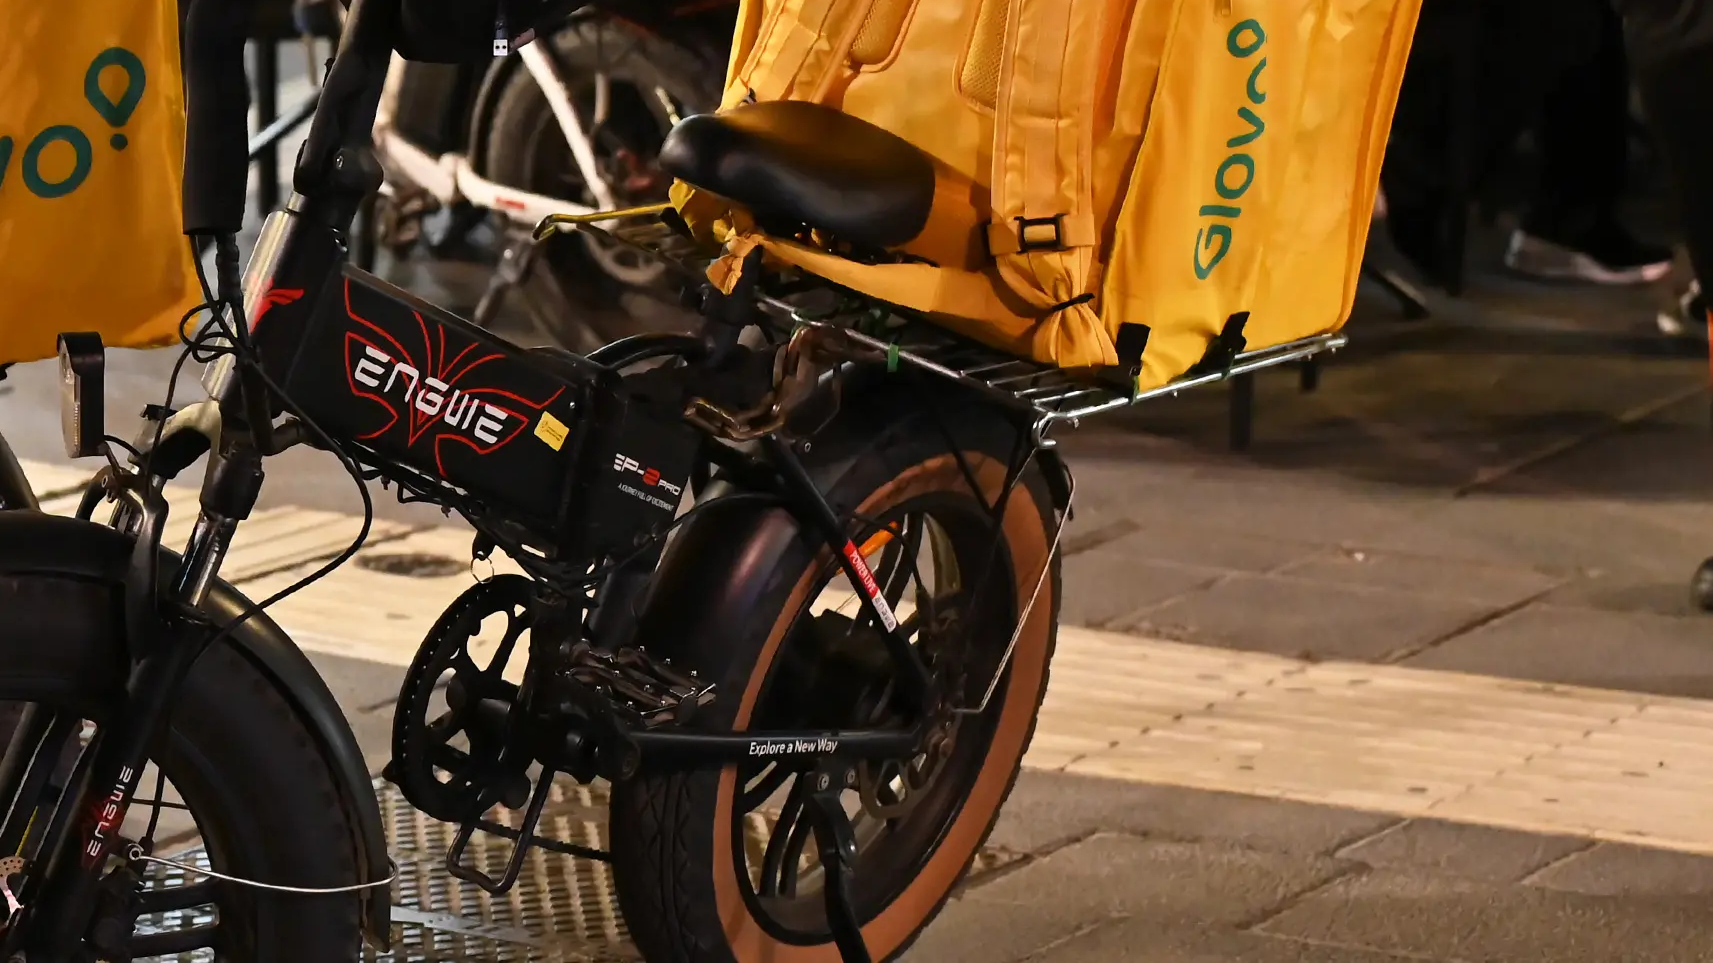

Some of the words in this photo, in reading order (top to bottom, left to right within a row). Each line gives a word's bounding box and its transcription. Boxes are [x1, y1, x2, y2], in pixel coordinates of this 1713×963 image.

[354, 345, 509, 444] ENGWE
[850, 550, 868, 579] POWER
[864, 574, 877, 594] LIVE
[749, 740, 786, 757] Explore
[786, 743, 793, 753] a
[795, 739, 816, 753] New
[817, 738, 838, 754] Way
